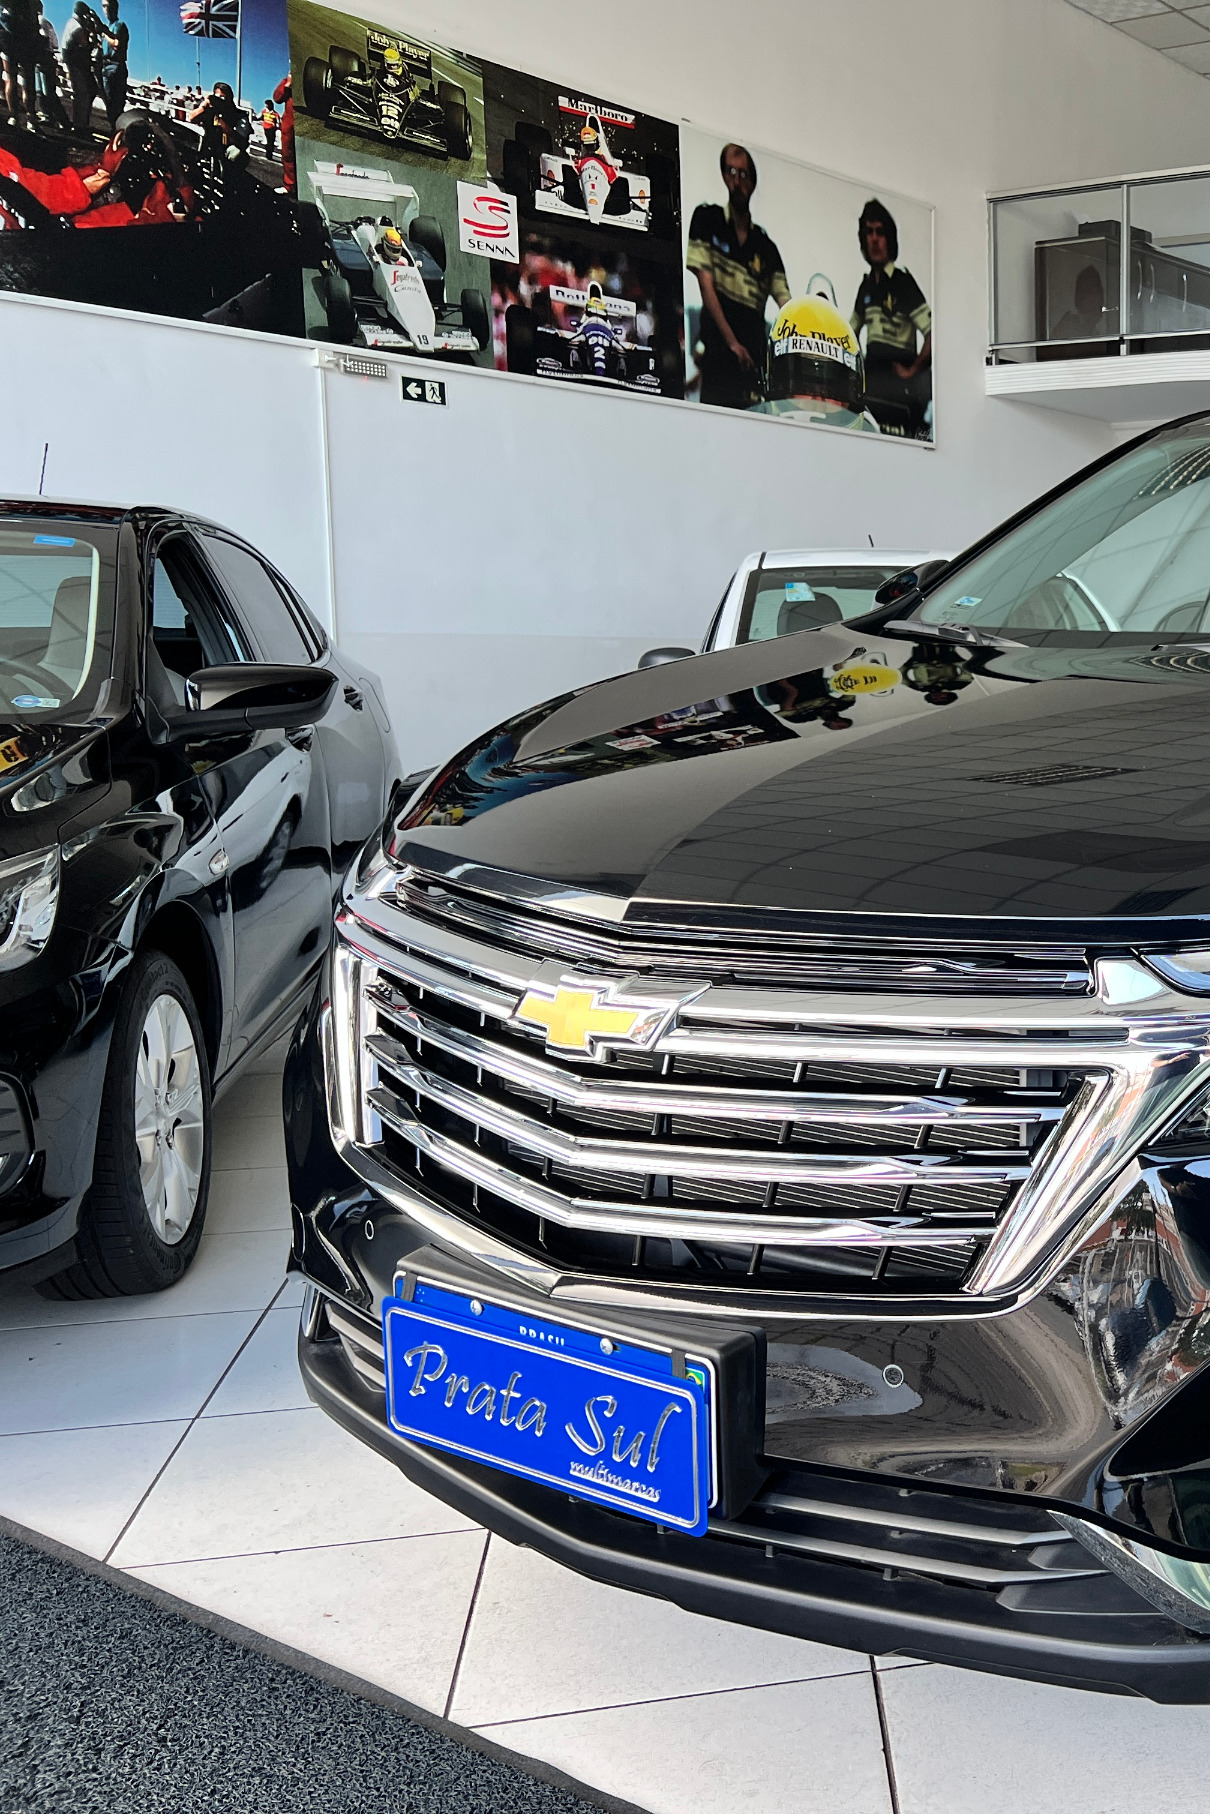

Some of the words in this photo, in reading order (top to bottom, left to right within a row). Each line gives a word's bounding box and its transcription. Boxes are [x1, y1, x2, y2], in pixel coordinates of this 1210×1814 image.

[567, 100, 629, 122] Marlboro
[467, 238, 516, 258] SENNA
[555, 289, 631, 312] Rothans
[416, 334, 430, 346] 19
[791, 337, 840, 359] RENAULT
[593, 346, 606, 360] 2
[404, 1341, 547, 1437] Prata
[565, 1395, 682, 1473] Sul
[569, 1460, 661, 1503] multimarcas
